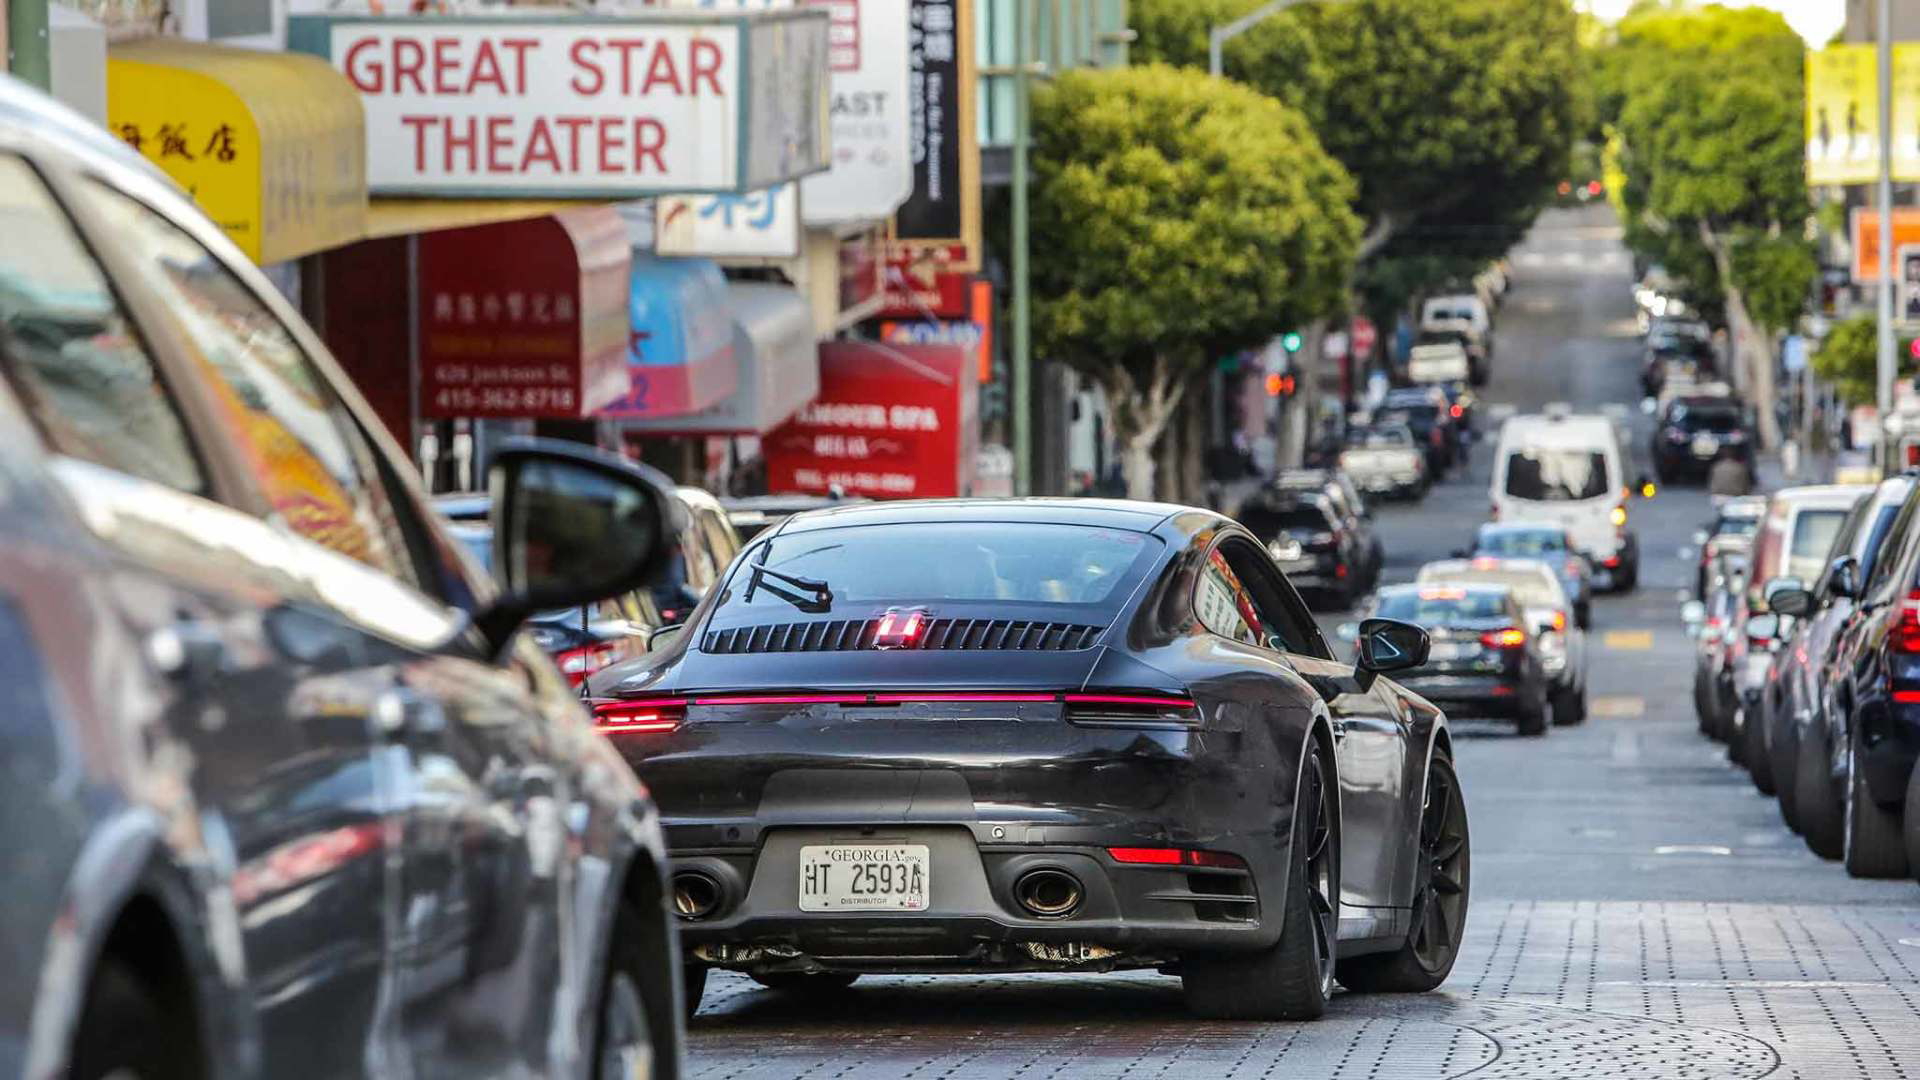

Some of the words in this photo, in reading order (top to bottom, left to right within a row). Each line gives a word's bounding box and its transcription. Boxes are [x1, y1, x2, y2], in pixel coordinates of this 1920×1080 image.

[345, 38, 540, 95] GREAT
[569, 38, 724, 96] STAR
[401, 115, 668, 174] THEATER
[805, 864, 831, 895] HT
